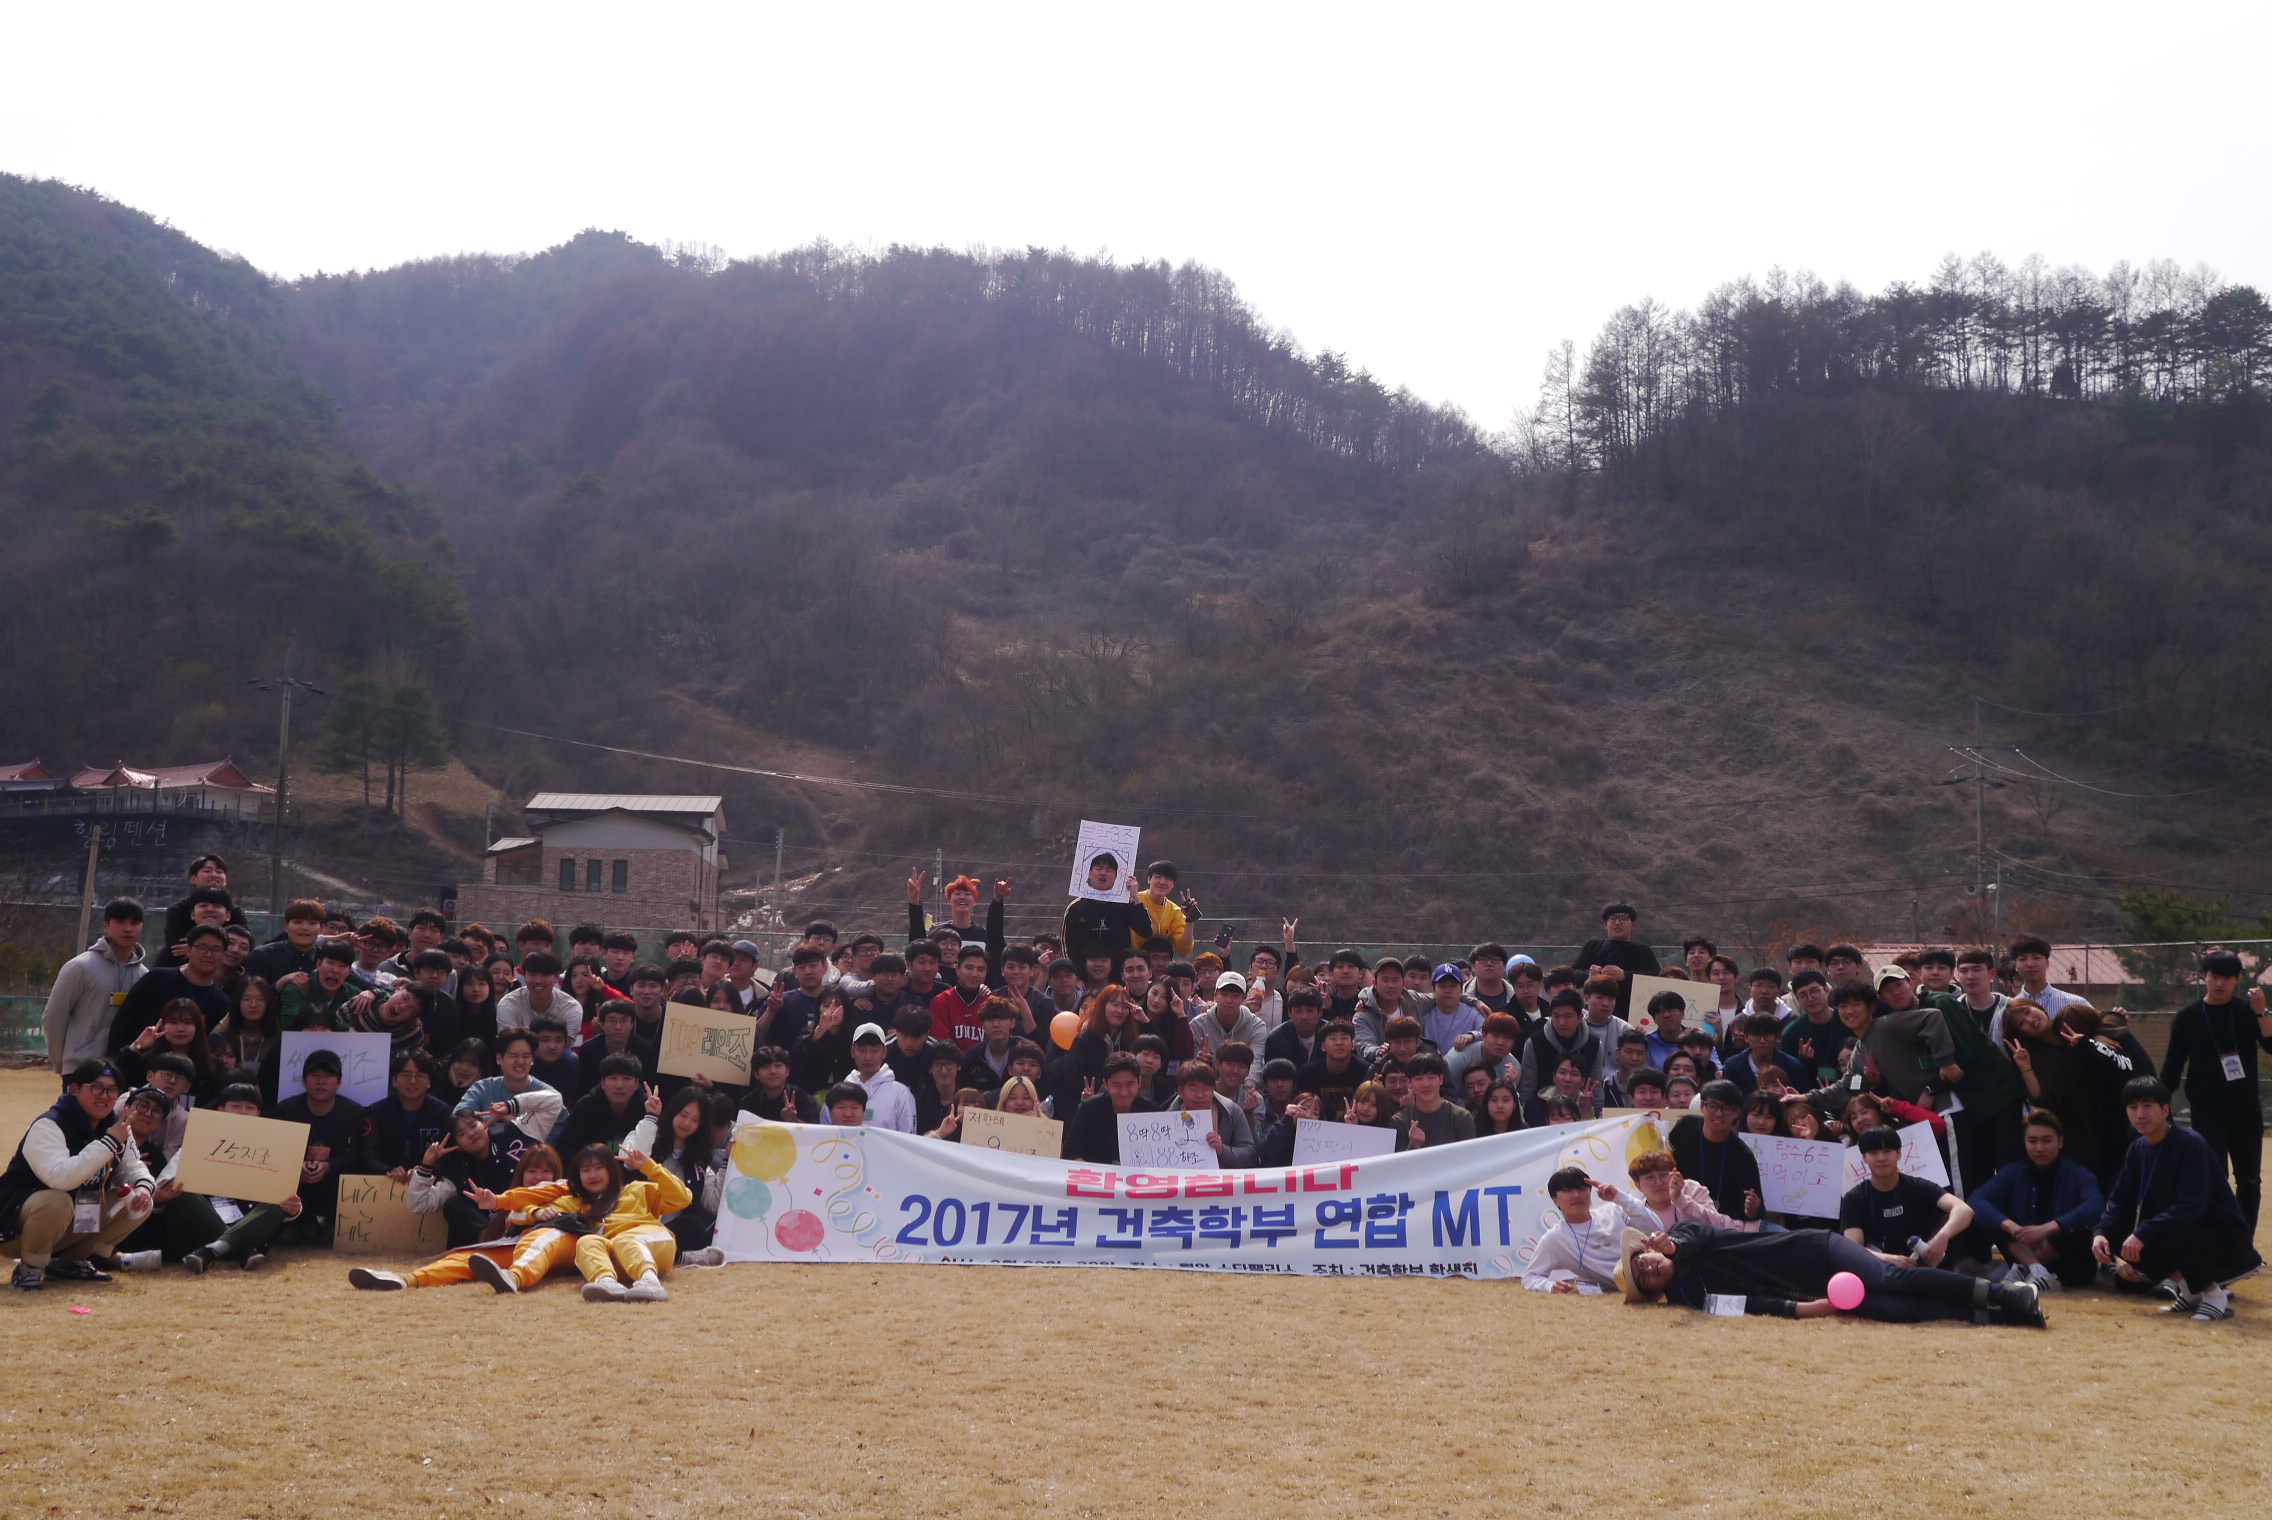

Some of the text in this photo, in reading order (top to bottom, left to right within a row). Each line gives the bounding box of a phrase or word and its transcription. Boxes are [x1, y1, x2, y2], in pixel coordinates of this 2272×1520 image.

[73, 819, 167, 849] 힐링펜션
[954, 1024, 986, 1042] UNLV
[968, 1111, 1005, 1127] 저한테
[1775, 1140, 1830, 1166] 탕수6은
[895, 1185, 1522, 1249] 2017년 건축학부 연합 MT
